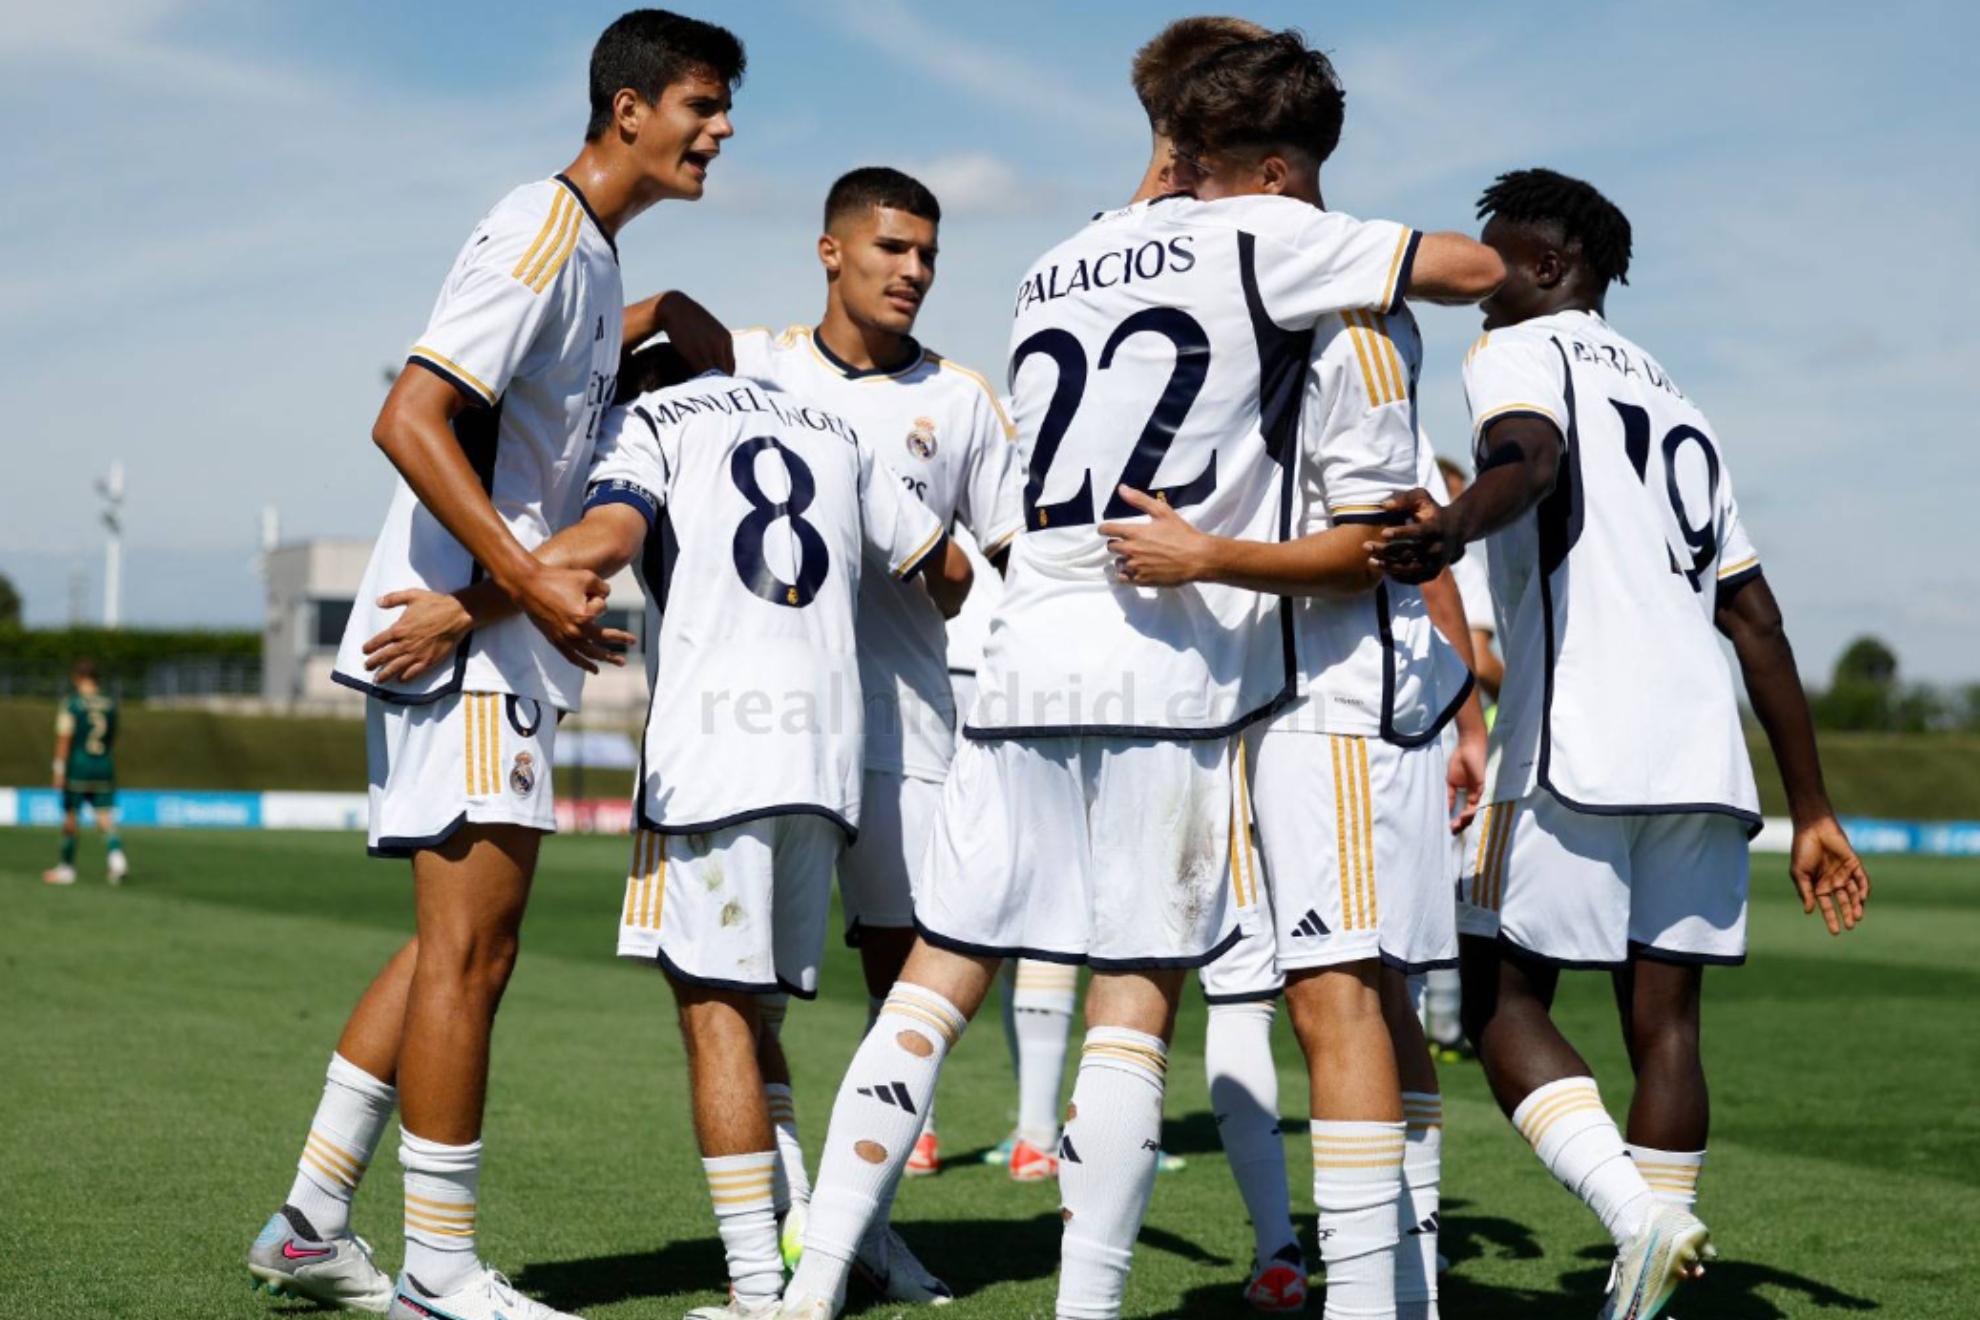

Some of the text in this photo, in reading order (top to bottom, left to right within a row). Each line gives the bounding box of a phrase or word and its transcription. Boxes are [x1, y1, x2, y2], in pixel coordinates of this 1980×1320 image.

[1014, 234, 1197, 318] PALACIOS
[654, 386, 769, 427] MANUEL
[1007, 306, 1218, 533] 22
[730, 435, 829, 609] 8
